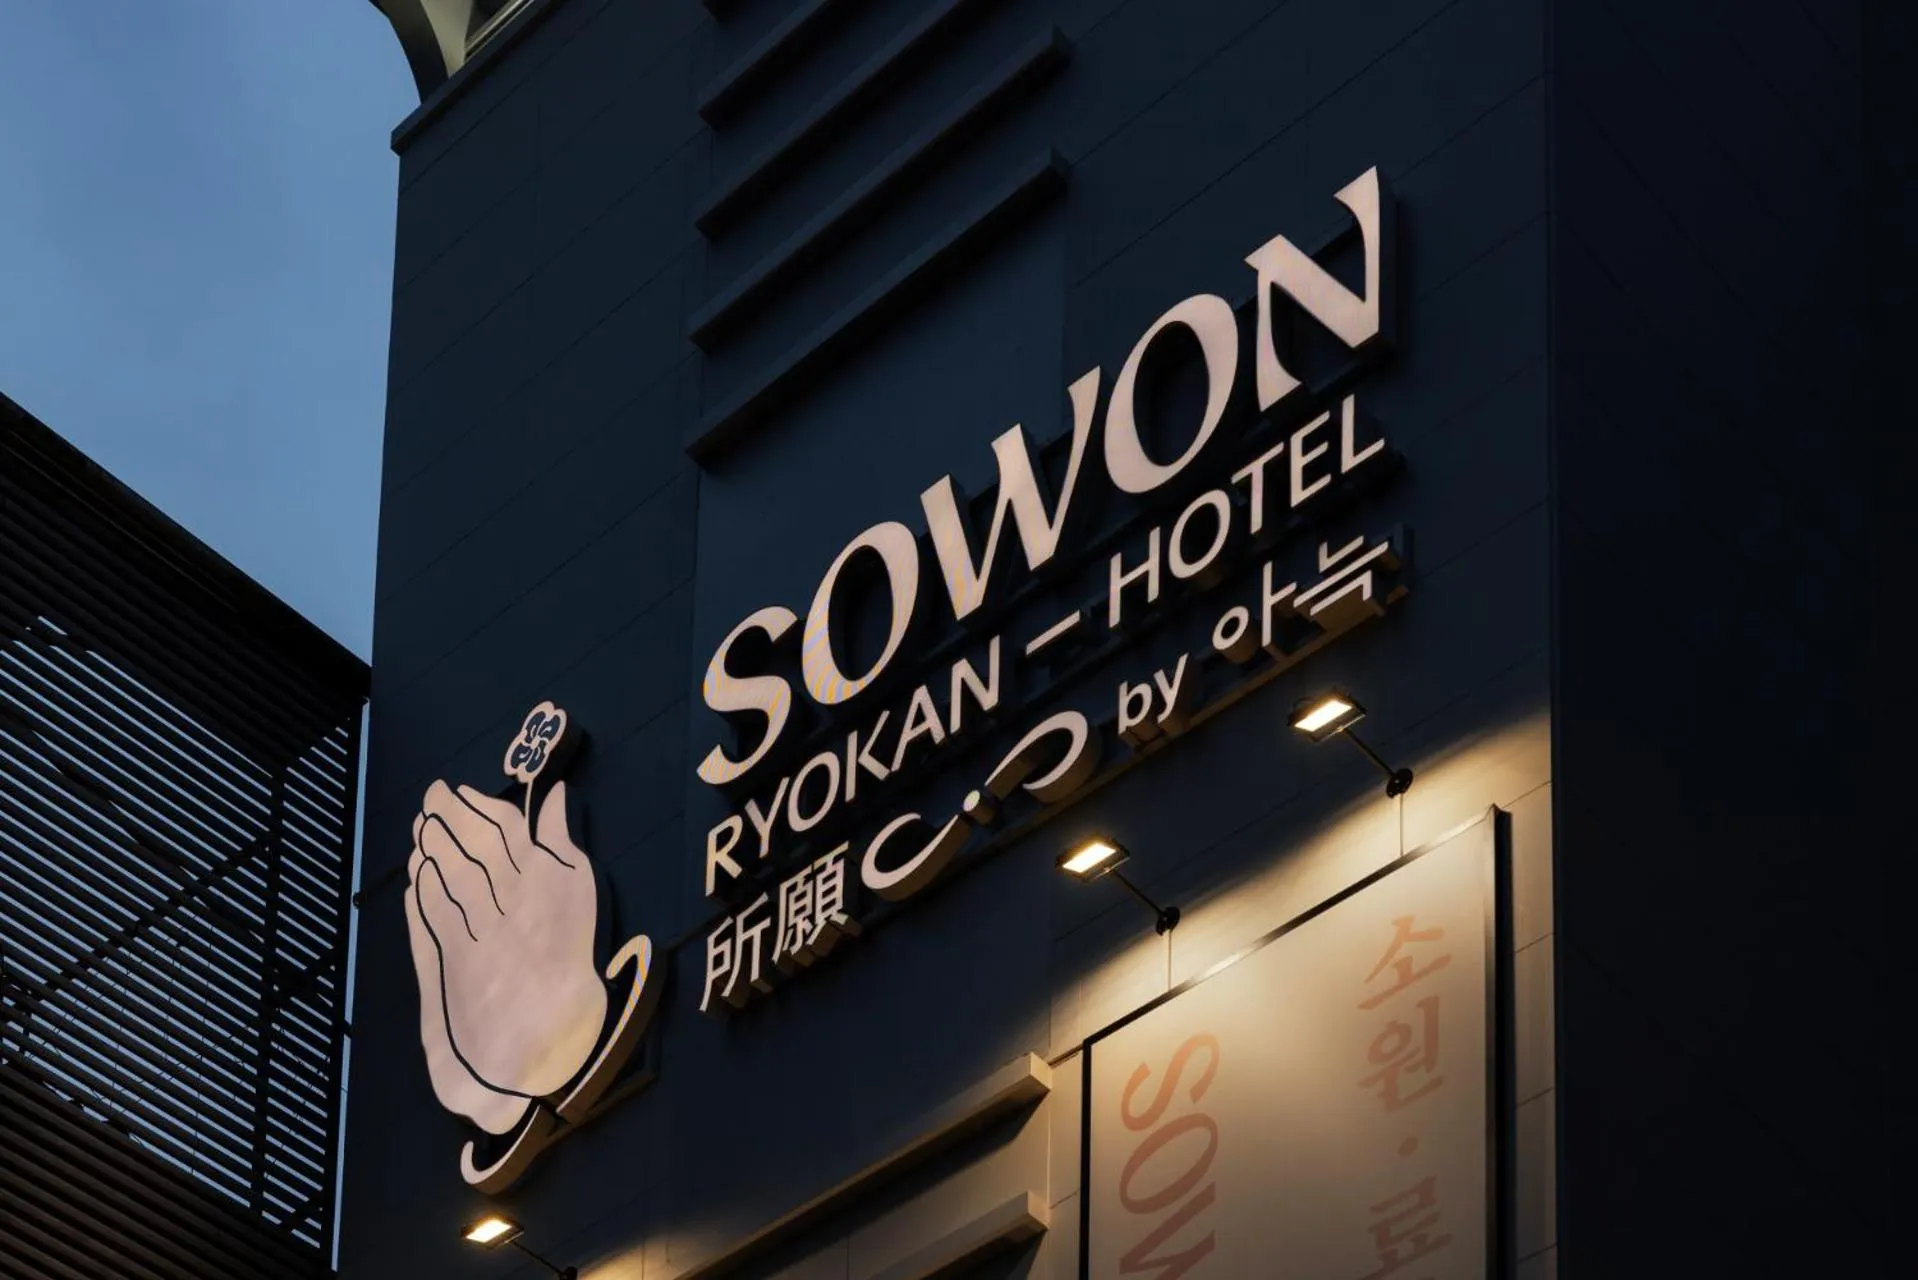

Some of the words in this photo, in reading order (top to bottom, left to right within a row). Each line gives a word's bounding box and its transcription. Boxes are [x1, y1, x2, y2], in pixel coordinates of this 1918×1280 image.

[697, 166, 1381, 785] SOWON
[705, 635, 1000, 897] RYOKAN
[1109, 394, 1385, 628] HOTEL
[1118, 653, 1189, 734] by
[1212, 535, 1389, 650] 아늑
[699, 841, 849, 1012] 所願
[1356, 1175, 1453, 1280] 료
